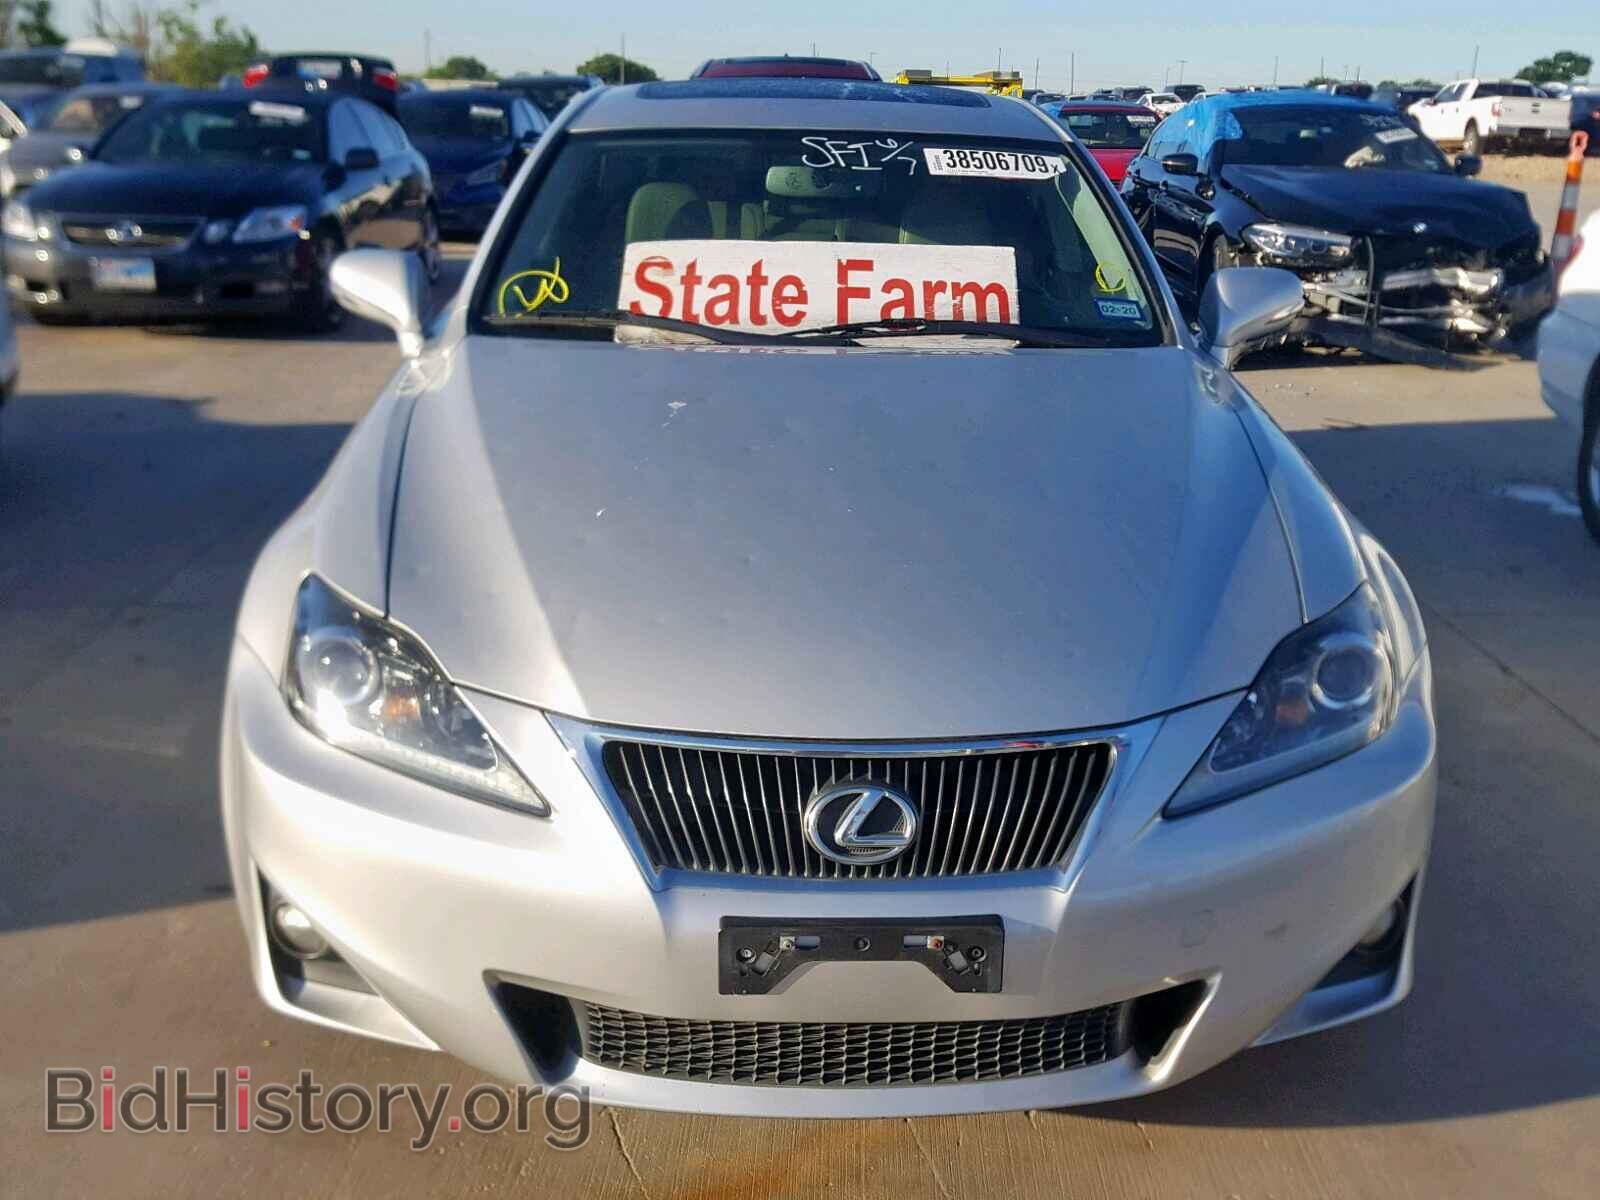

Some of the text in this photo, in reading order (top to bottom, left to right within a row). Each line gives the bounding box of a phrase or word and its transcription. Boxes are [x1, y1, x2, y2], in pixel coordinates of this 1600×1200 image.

[944, 149, 1049, 174] 38506709
[628, 255, 809, 328] State
[836, 258, 1011, 326] Farm
